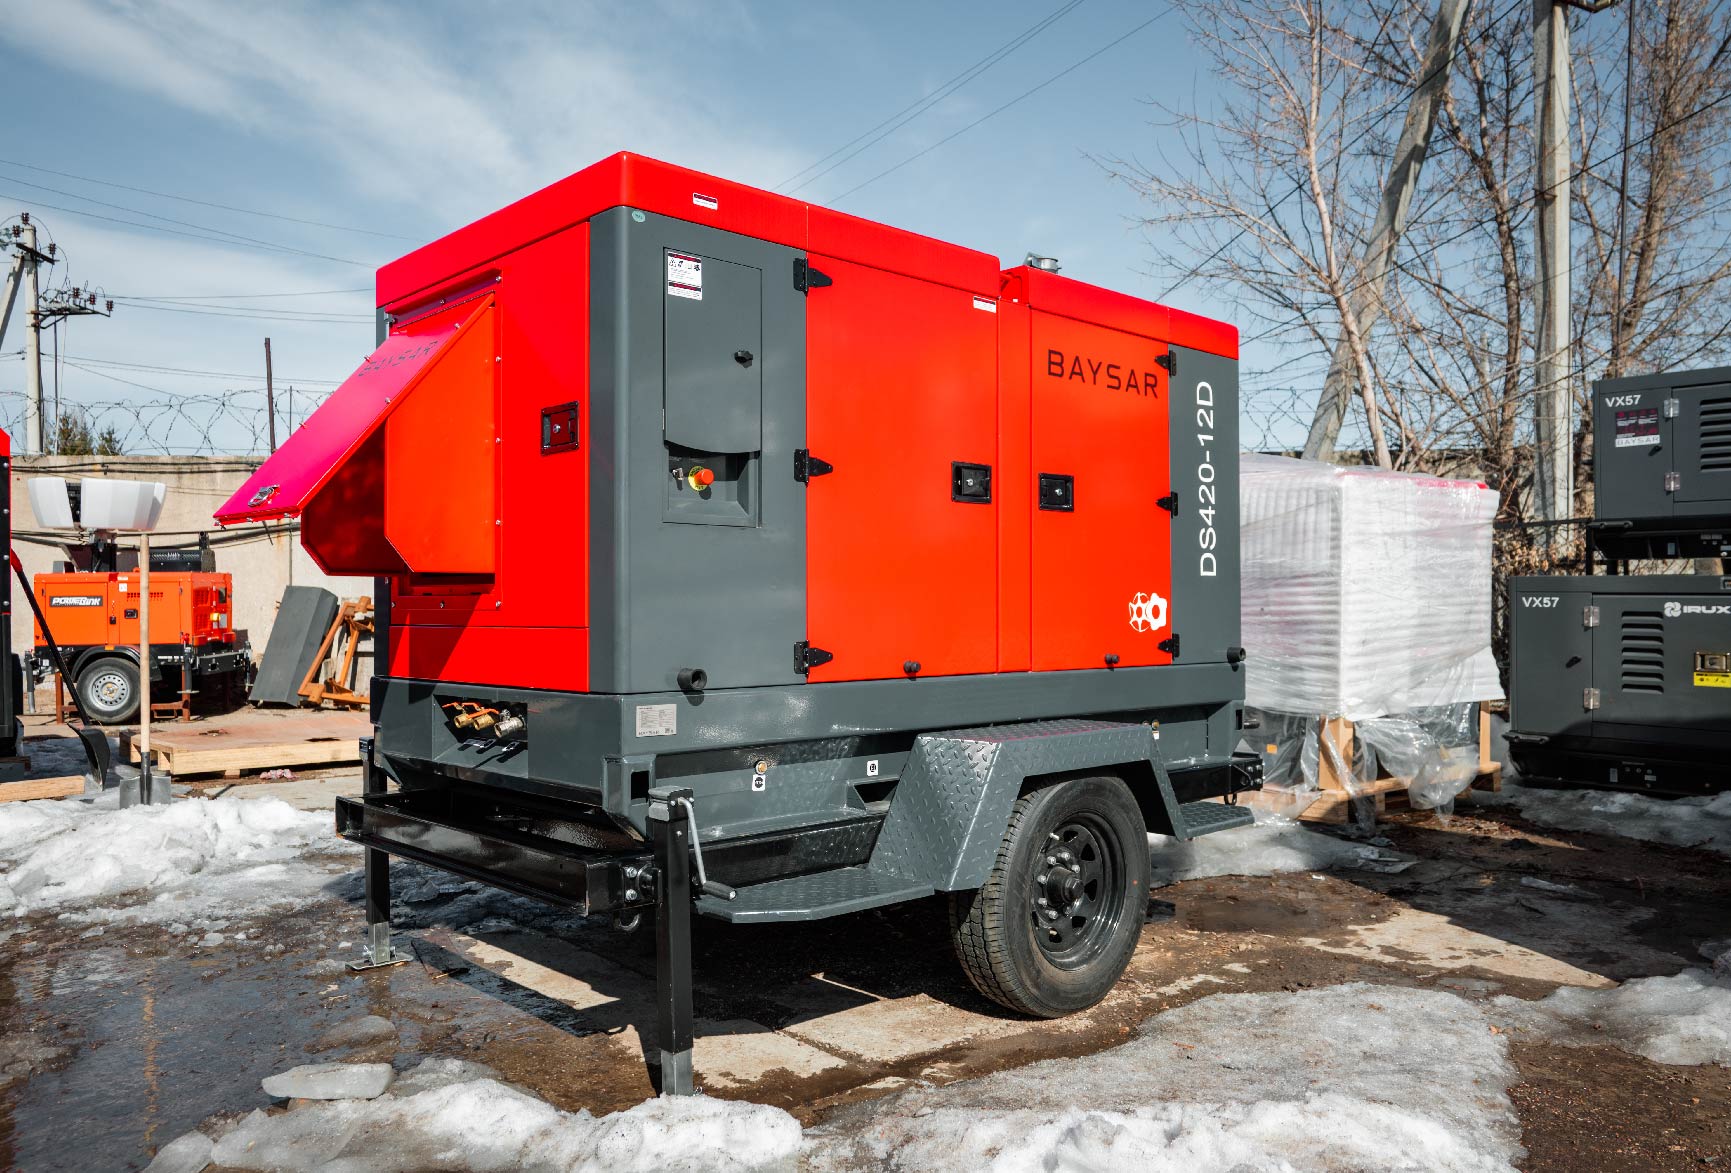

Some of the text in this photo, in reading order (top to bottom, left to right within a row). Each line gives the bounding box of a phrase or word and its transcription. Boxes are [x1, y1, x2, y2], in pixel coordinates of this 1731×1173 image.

[1048, 349, 1158, 399] BAYSAR
[1605, 394, 1641, 408] VX57
[1196, 381, 1217, 577] DS420-12D
[1521, 597, 1560, 608] VX57
